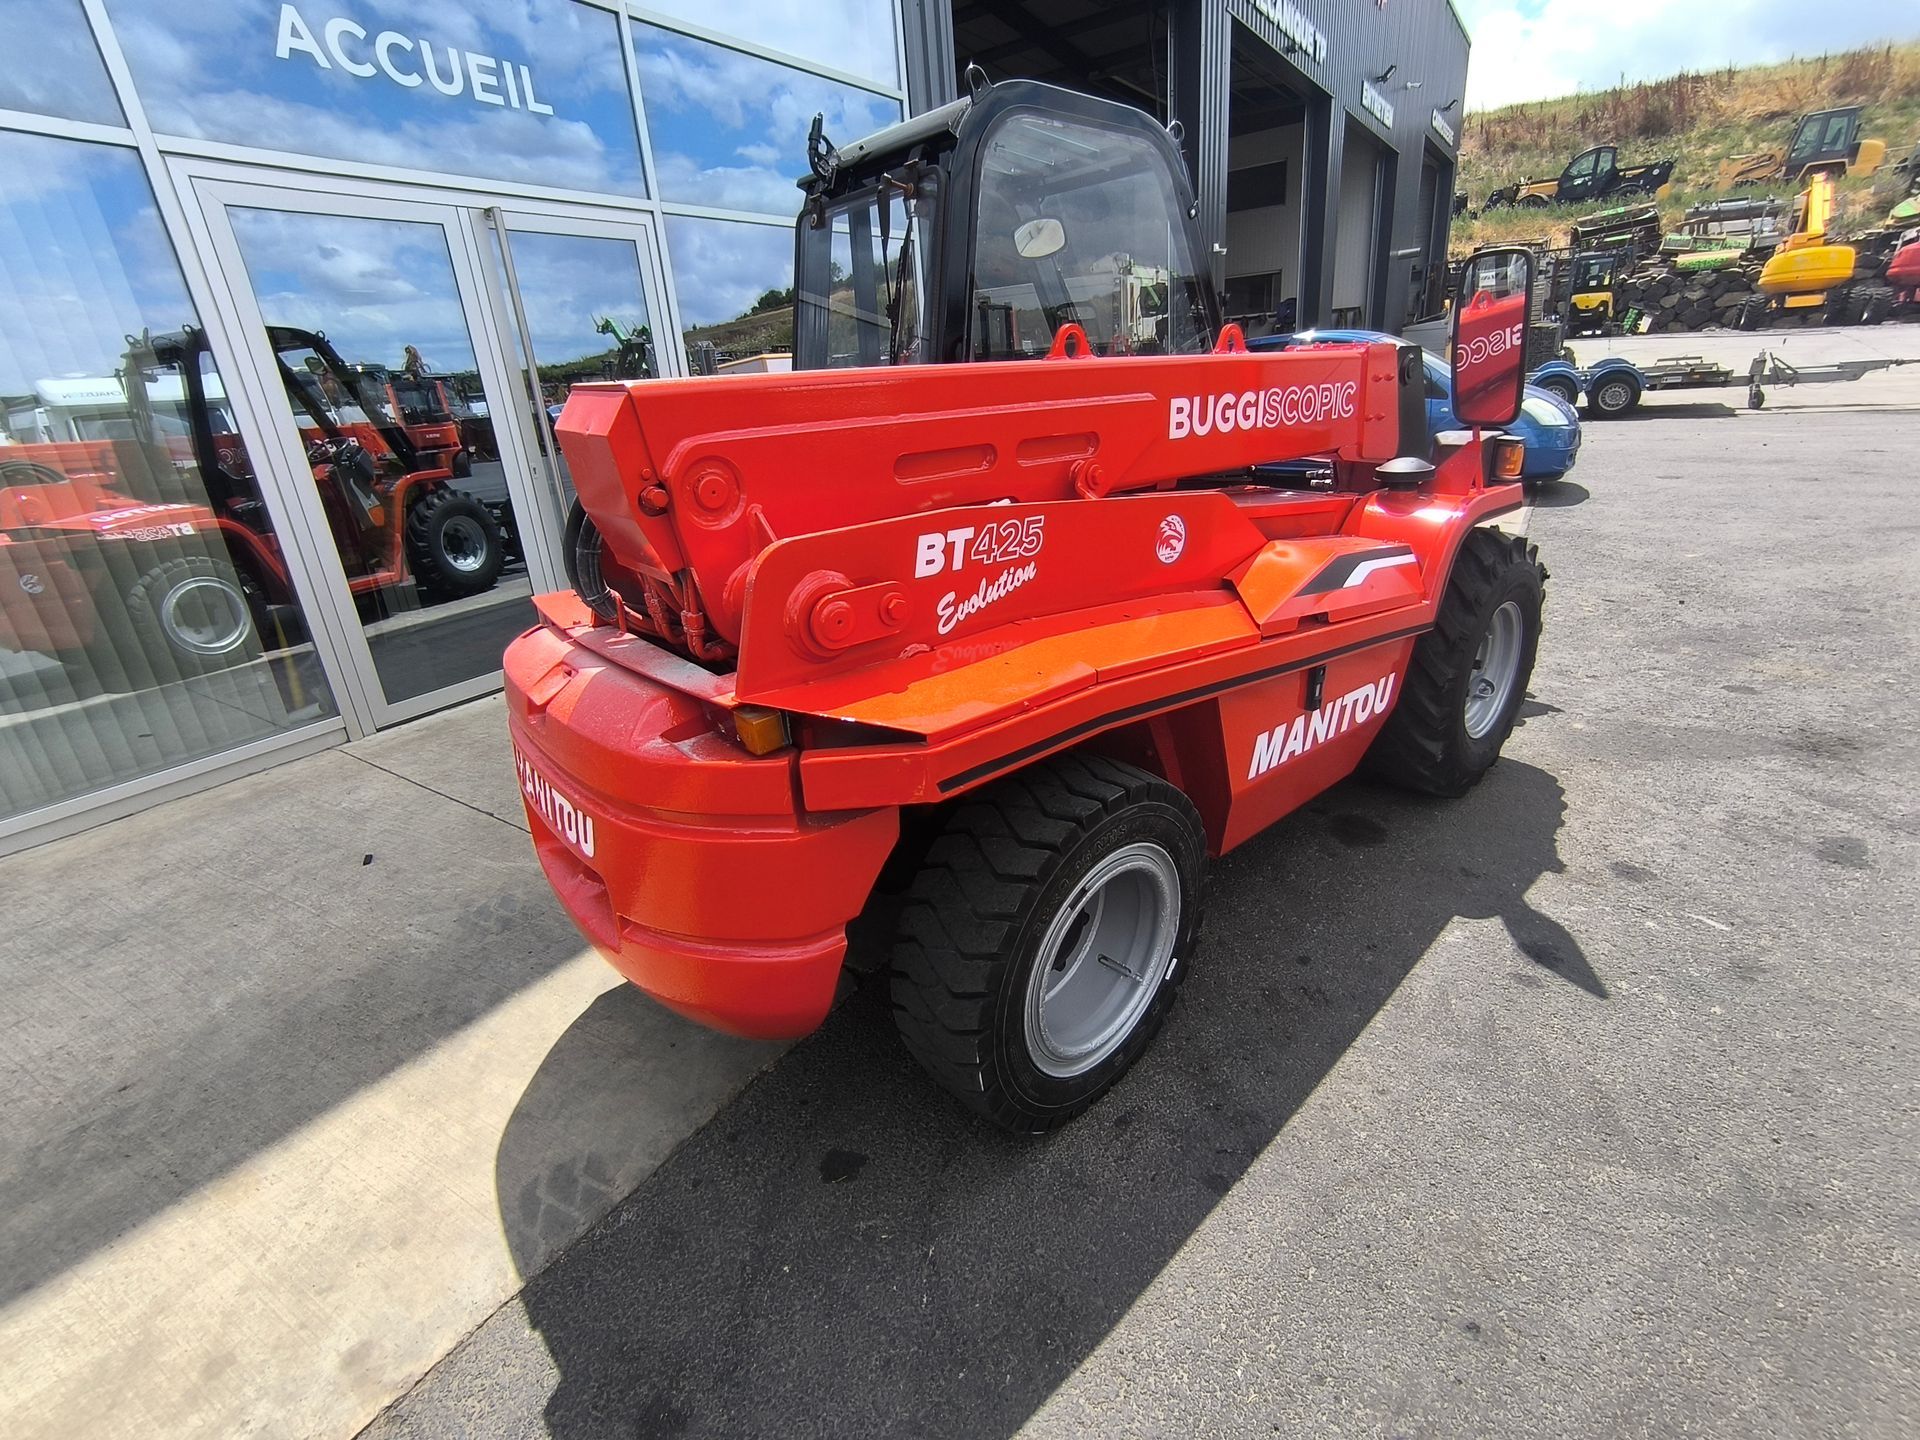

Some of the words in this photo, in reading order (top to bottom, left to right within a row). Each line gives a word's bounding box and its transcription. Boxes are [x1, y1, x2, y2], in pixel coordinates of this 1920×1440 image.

[276, 3, 554, 116] ACCUEIL
[1168, 381, 1356, 440] BUGGISCOPIC
[914, 514, 1045, 579] BT425
[936, 560, 1037, 636] Evolution
[1247, 671, 1396, 781] MANITOU
